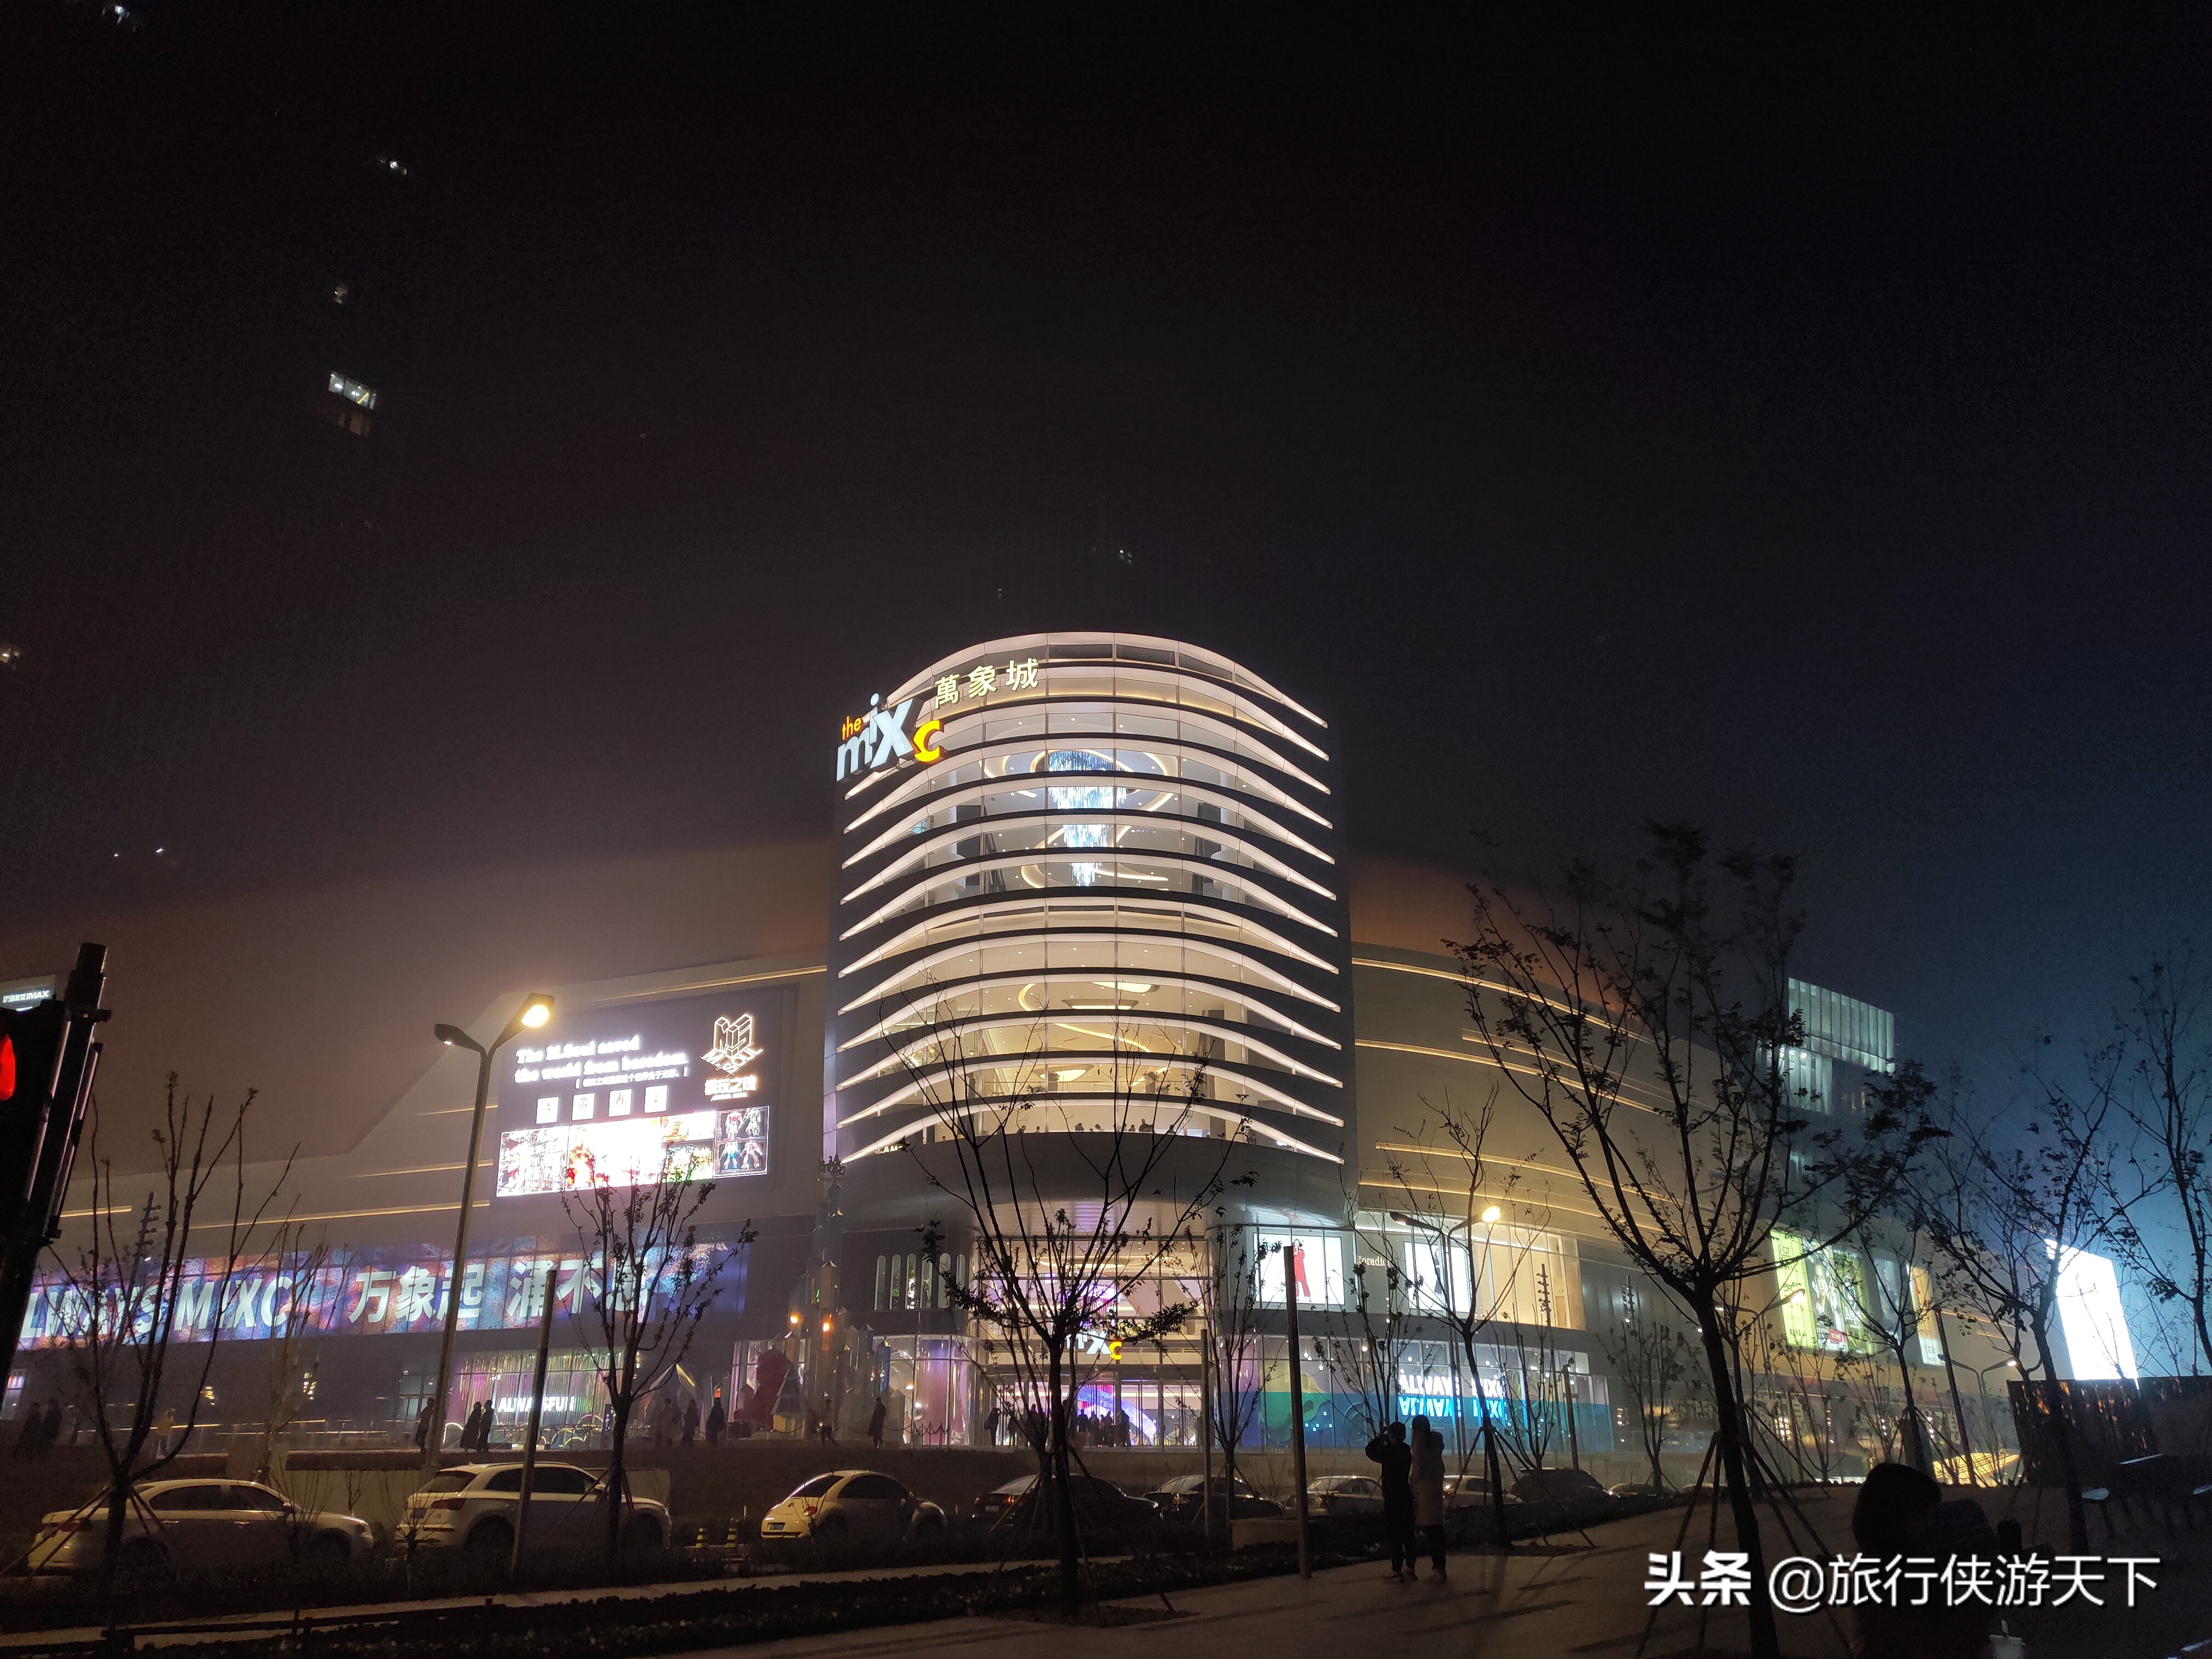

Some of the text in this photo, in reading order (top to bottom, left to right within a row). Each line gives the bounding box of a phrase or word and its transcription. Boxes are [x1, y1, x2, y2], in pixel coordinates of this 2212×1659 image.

[935, 658, 1039, 709] 萬象城
[842, 716, 862, 740] the
[20, 1277, 293, 1339] LWAYS MIXC
[498, 1397, 575, 1412] ALWASFUN
